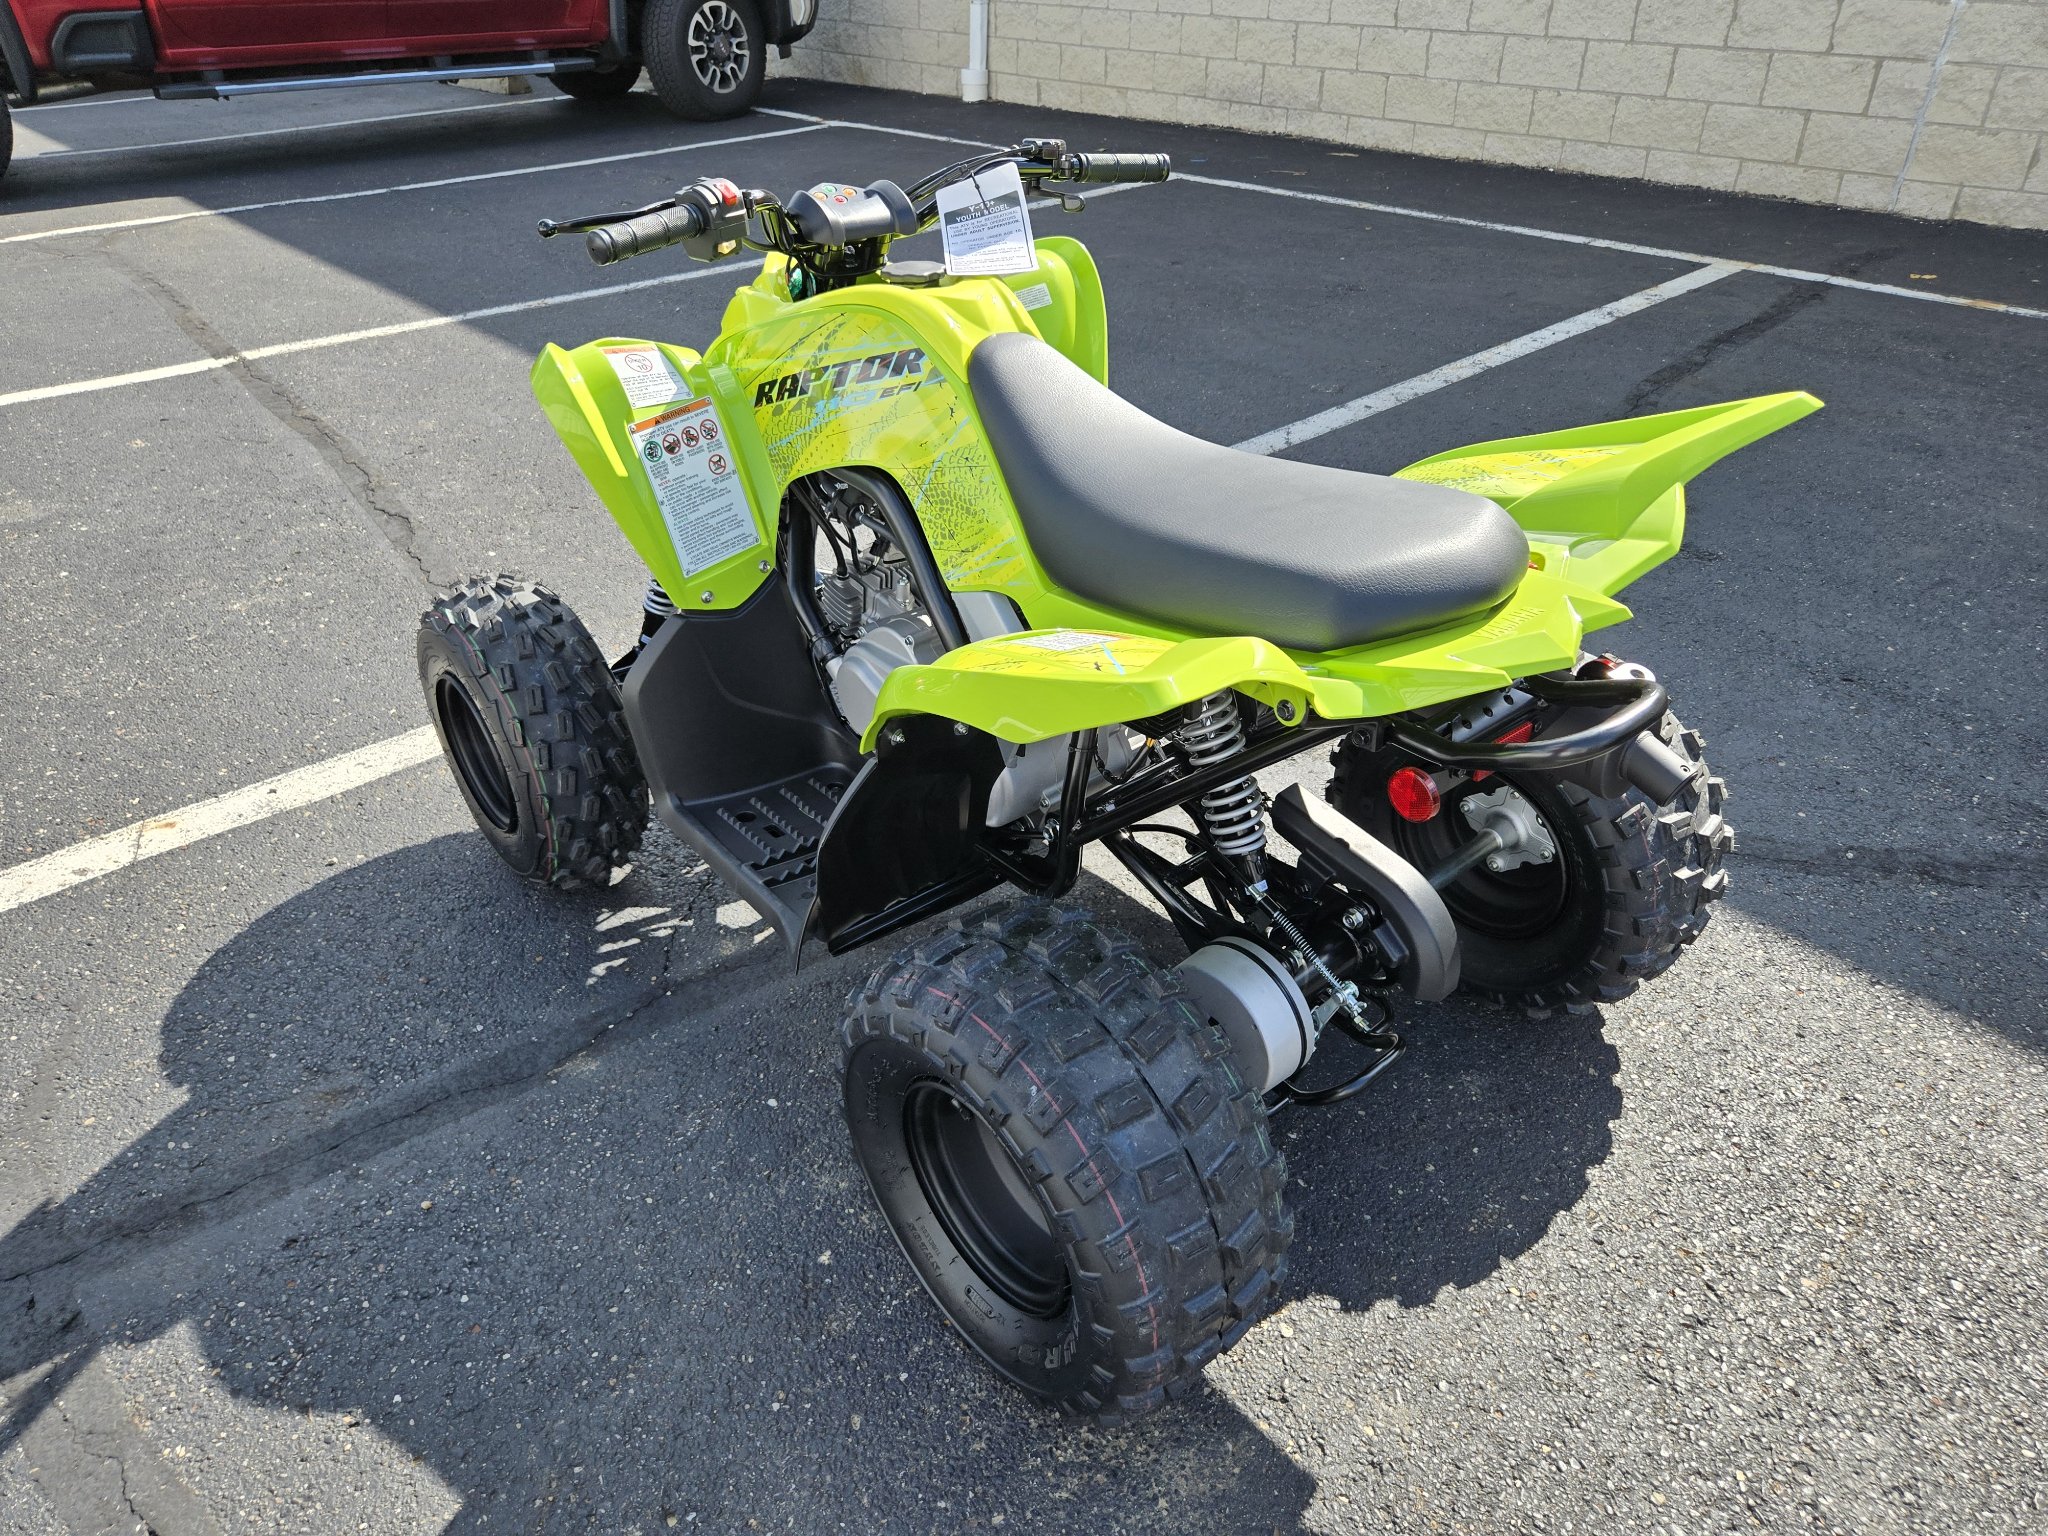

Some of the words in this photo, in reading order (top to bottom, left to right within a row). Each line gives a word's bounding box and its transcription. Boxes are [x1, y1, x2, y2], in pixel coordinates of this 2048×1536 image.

[956, 212, 981, 222] YOUTH
[984, 204, 1010, 214] MODEL
[754, 347, 926, 407] RAPTOR
[879, 381, 922, 399] EFI
[660, 407, 690, 421] WARNING
